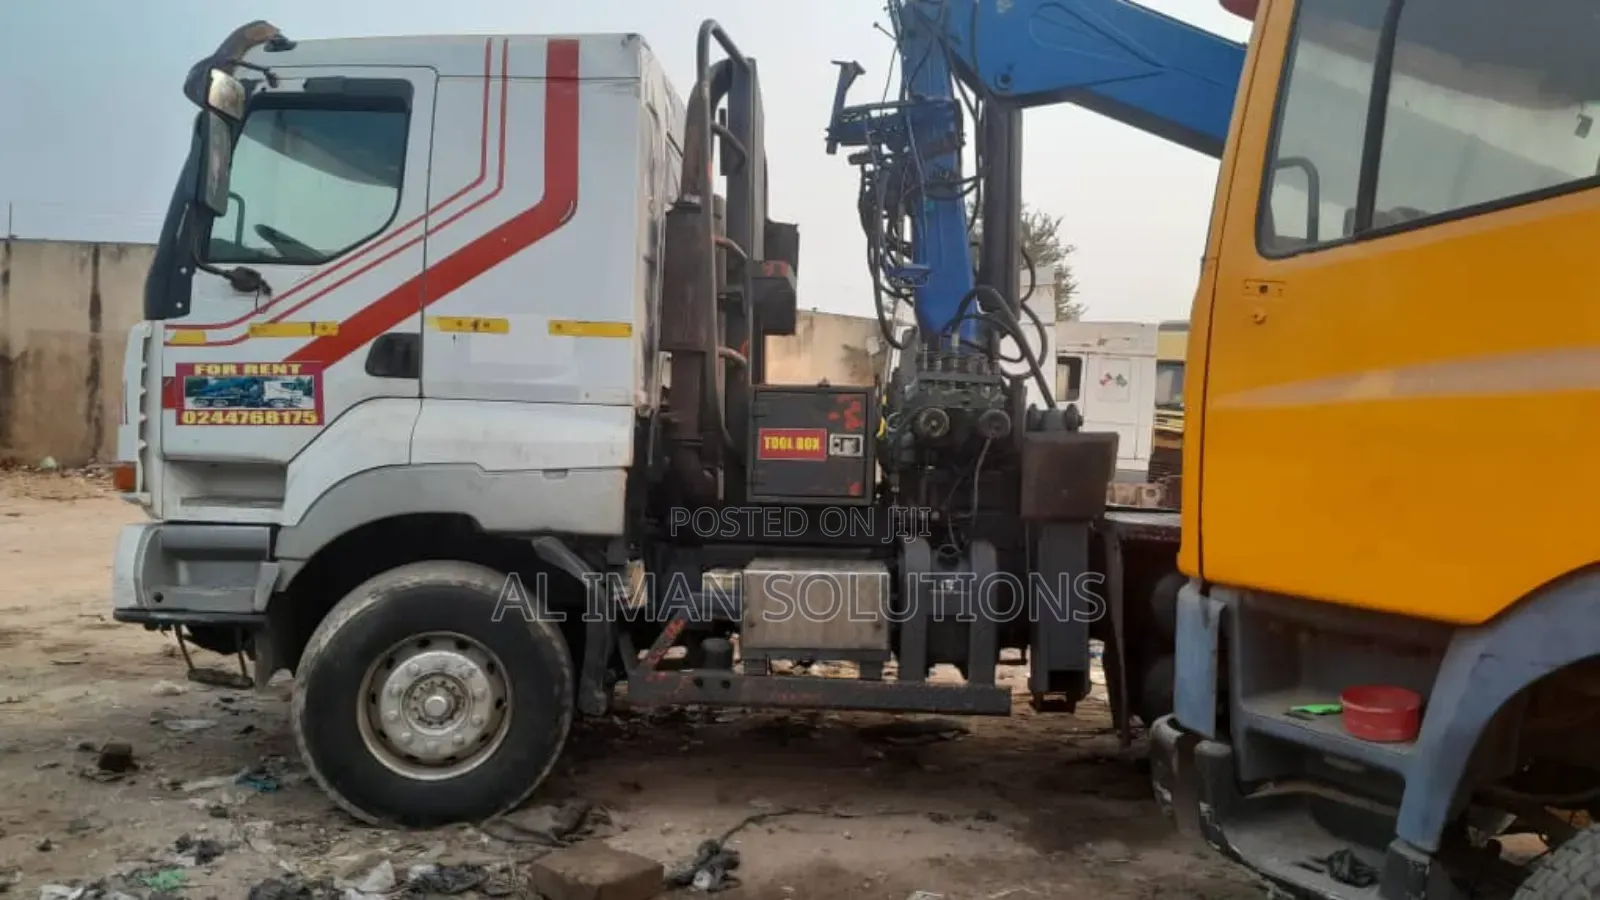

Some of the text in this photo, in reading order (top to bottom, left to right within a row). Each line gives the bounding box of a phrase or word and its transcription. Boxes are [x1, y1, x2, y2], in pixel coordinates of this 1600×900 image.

[194, 363, 301, 375] FOR RENT
[764, 436, 819, 451] TOOL BOX
